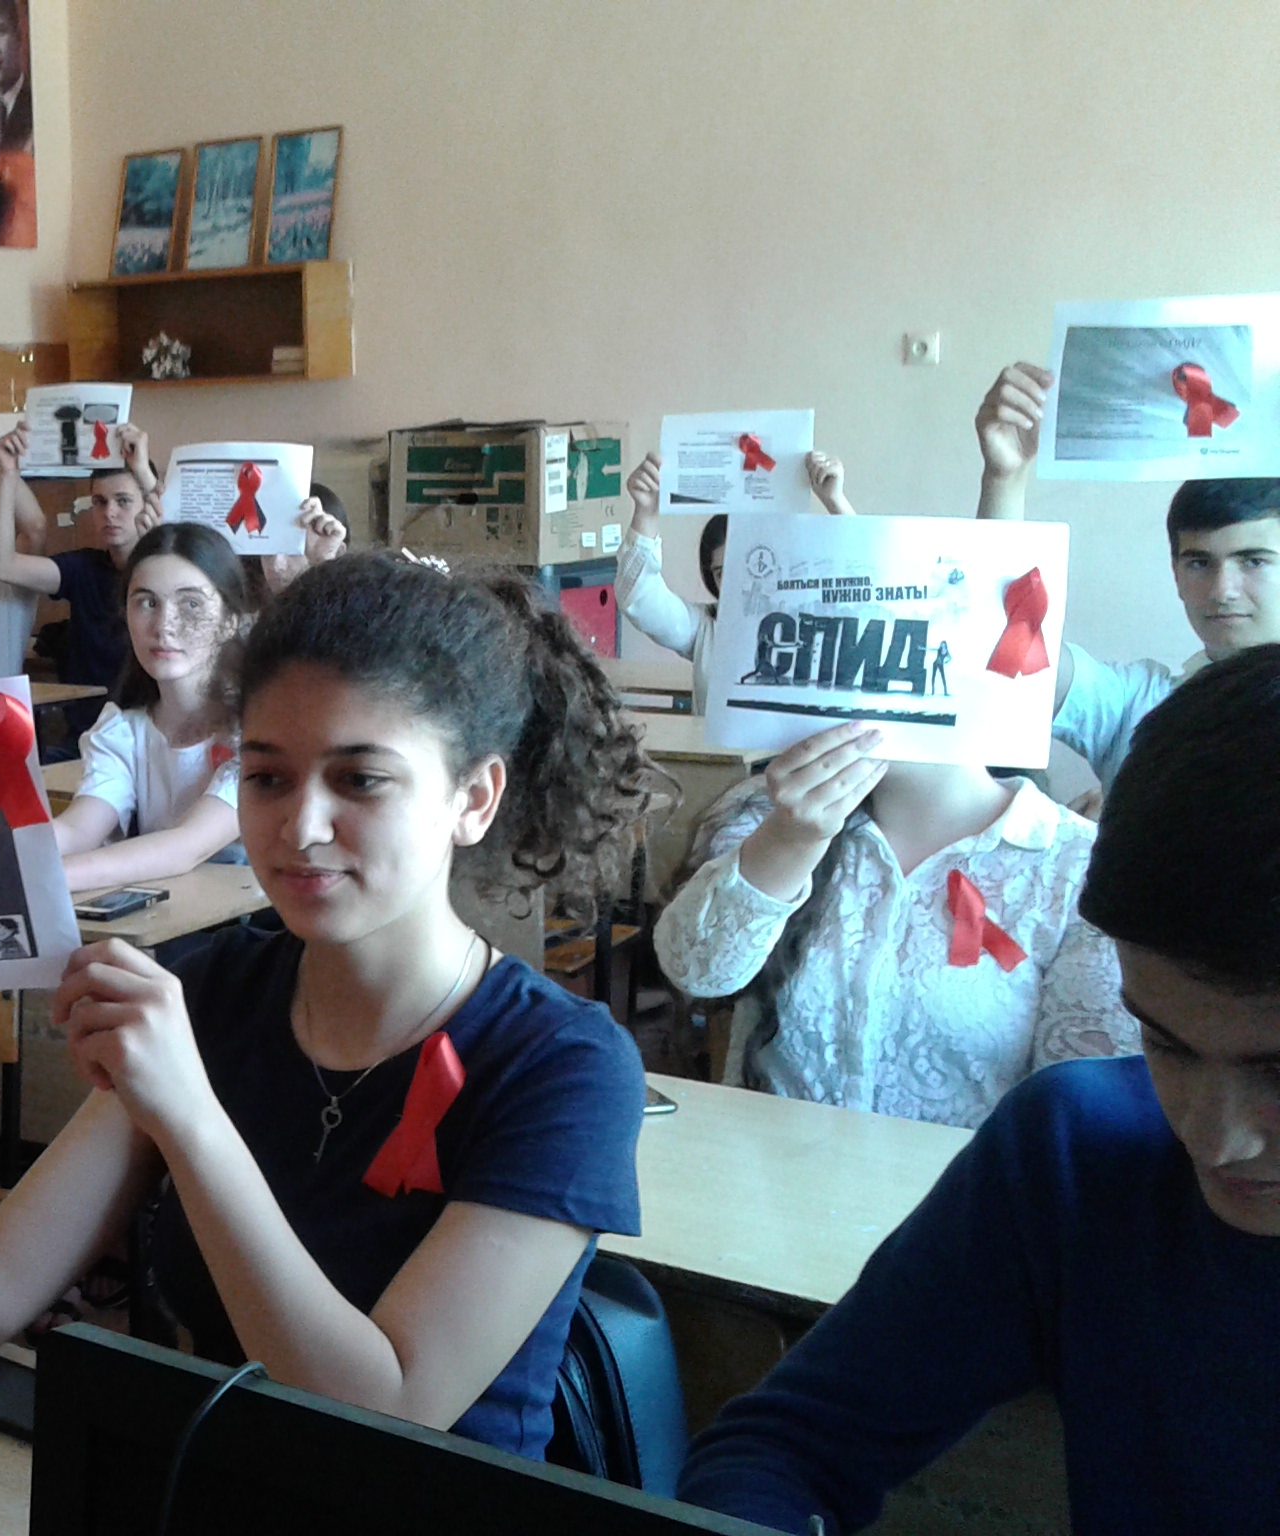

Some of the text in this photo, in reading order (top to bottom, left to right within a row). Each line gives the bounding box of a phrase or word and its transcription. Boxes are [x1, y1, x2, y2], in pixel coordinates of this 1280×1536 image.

[777, 578, 820, 591] БОЯТЬСЯ
[821, 577, 834, 589] НЕ
[821, 585, 928, 604] НУЖНО ЗНАТЬ!
[755, 611, 929, 697] СПИД
